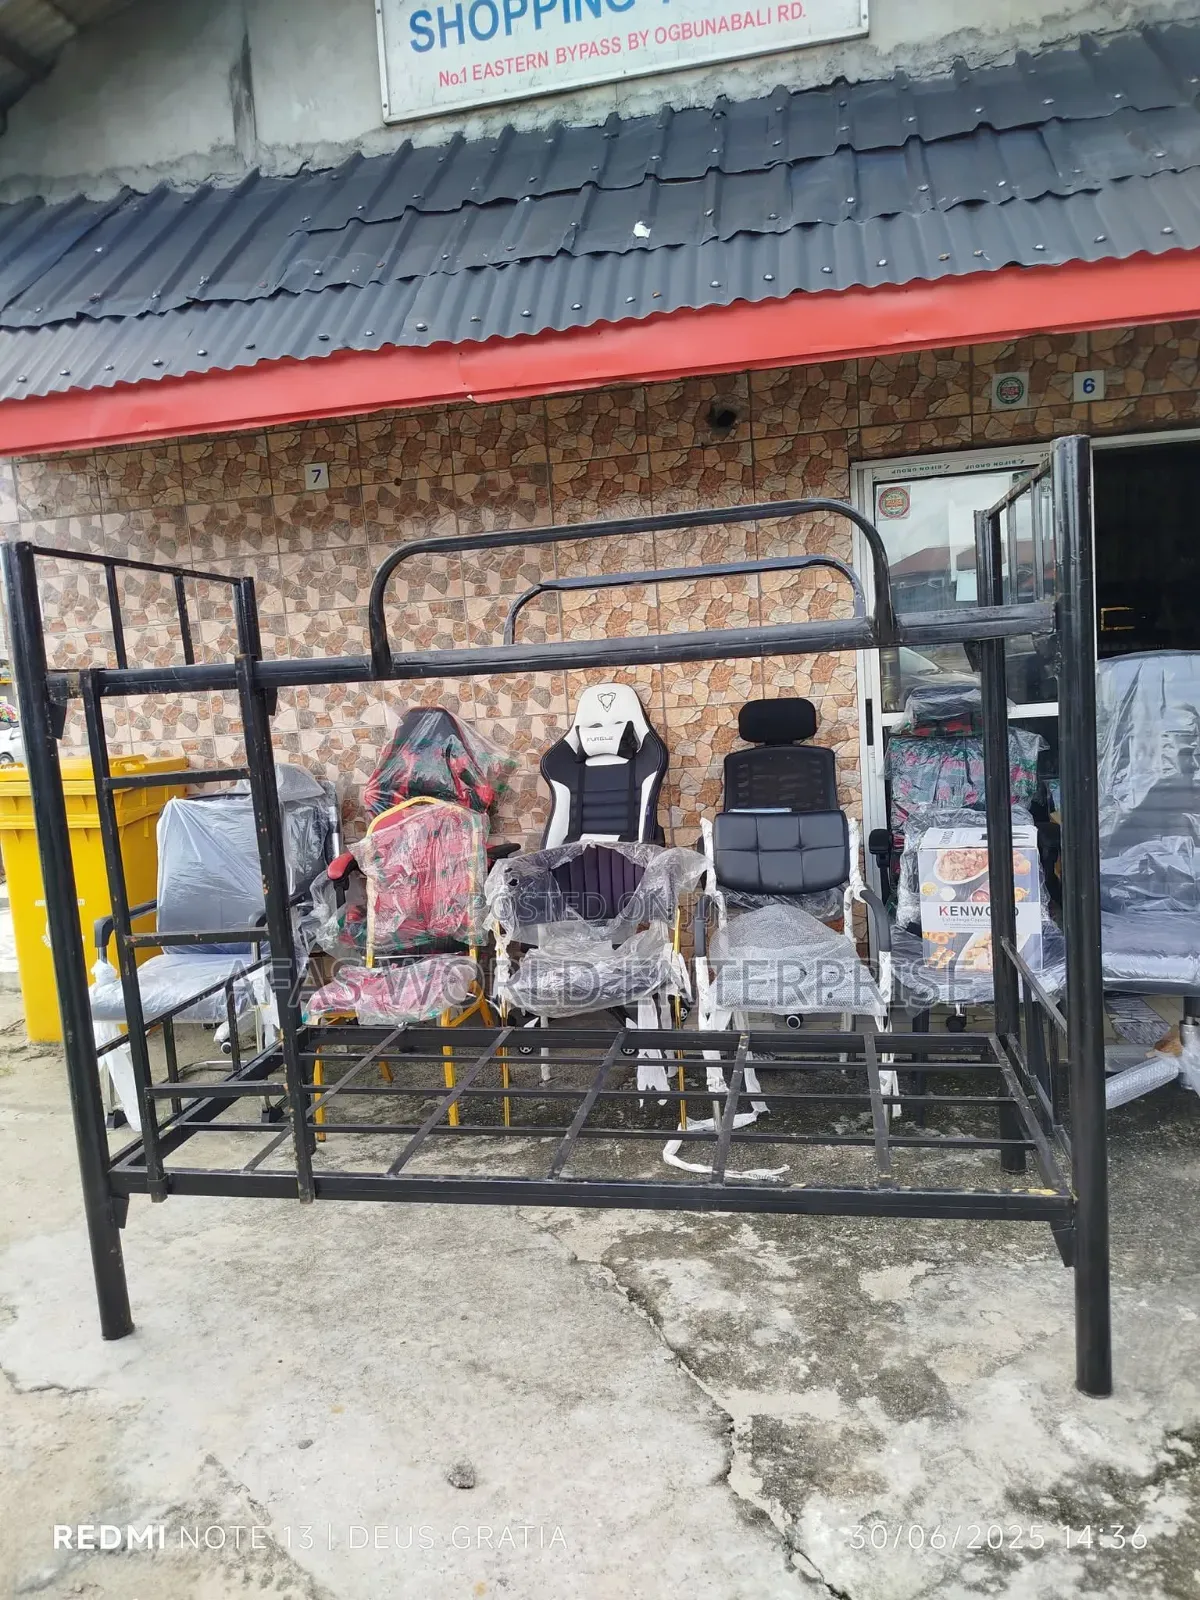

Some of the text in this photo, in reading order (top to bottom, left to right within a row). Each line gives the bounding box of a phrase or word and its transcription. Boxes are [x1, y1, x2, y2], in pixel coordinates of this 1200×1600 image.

[472, 50, 549, 81] EASTERN
[555, 36, 622, 64] BYPASS
[627, 30, 650, 50] BY
[654, 7, 772, 44] OGBUNABALI
[777, 2, 807, 23] RD.
[1083, 377, 1096, 394] 6
[311, 469, 322, 484] 7
